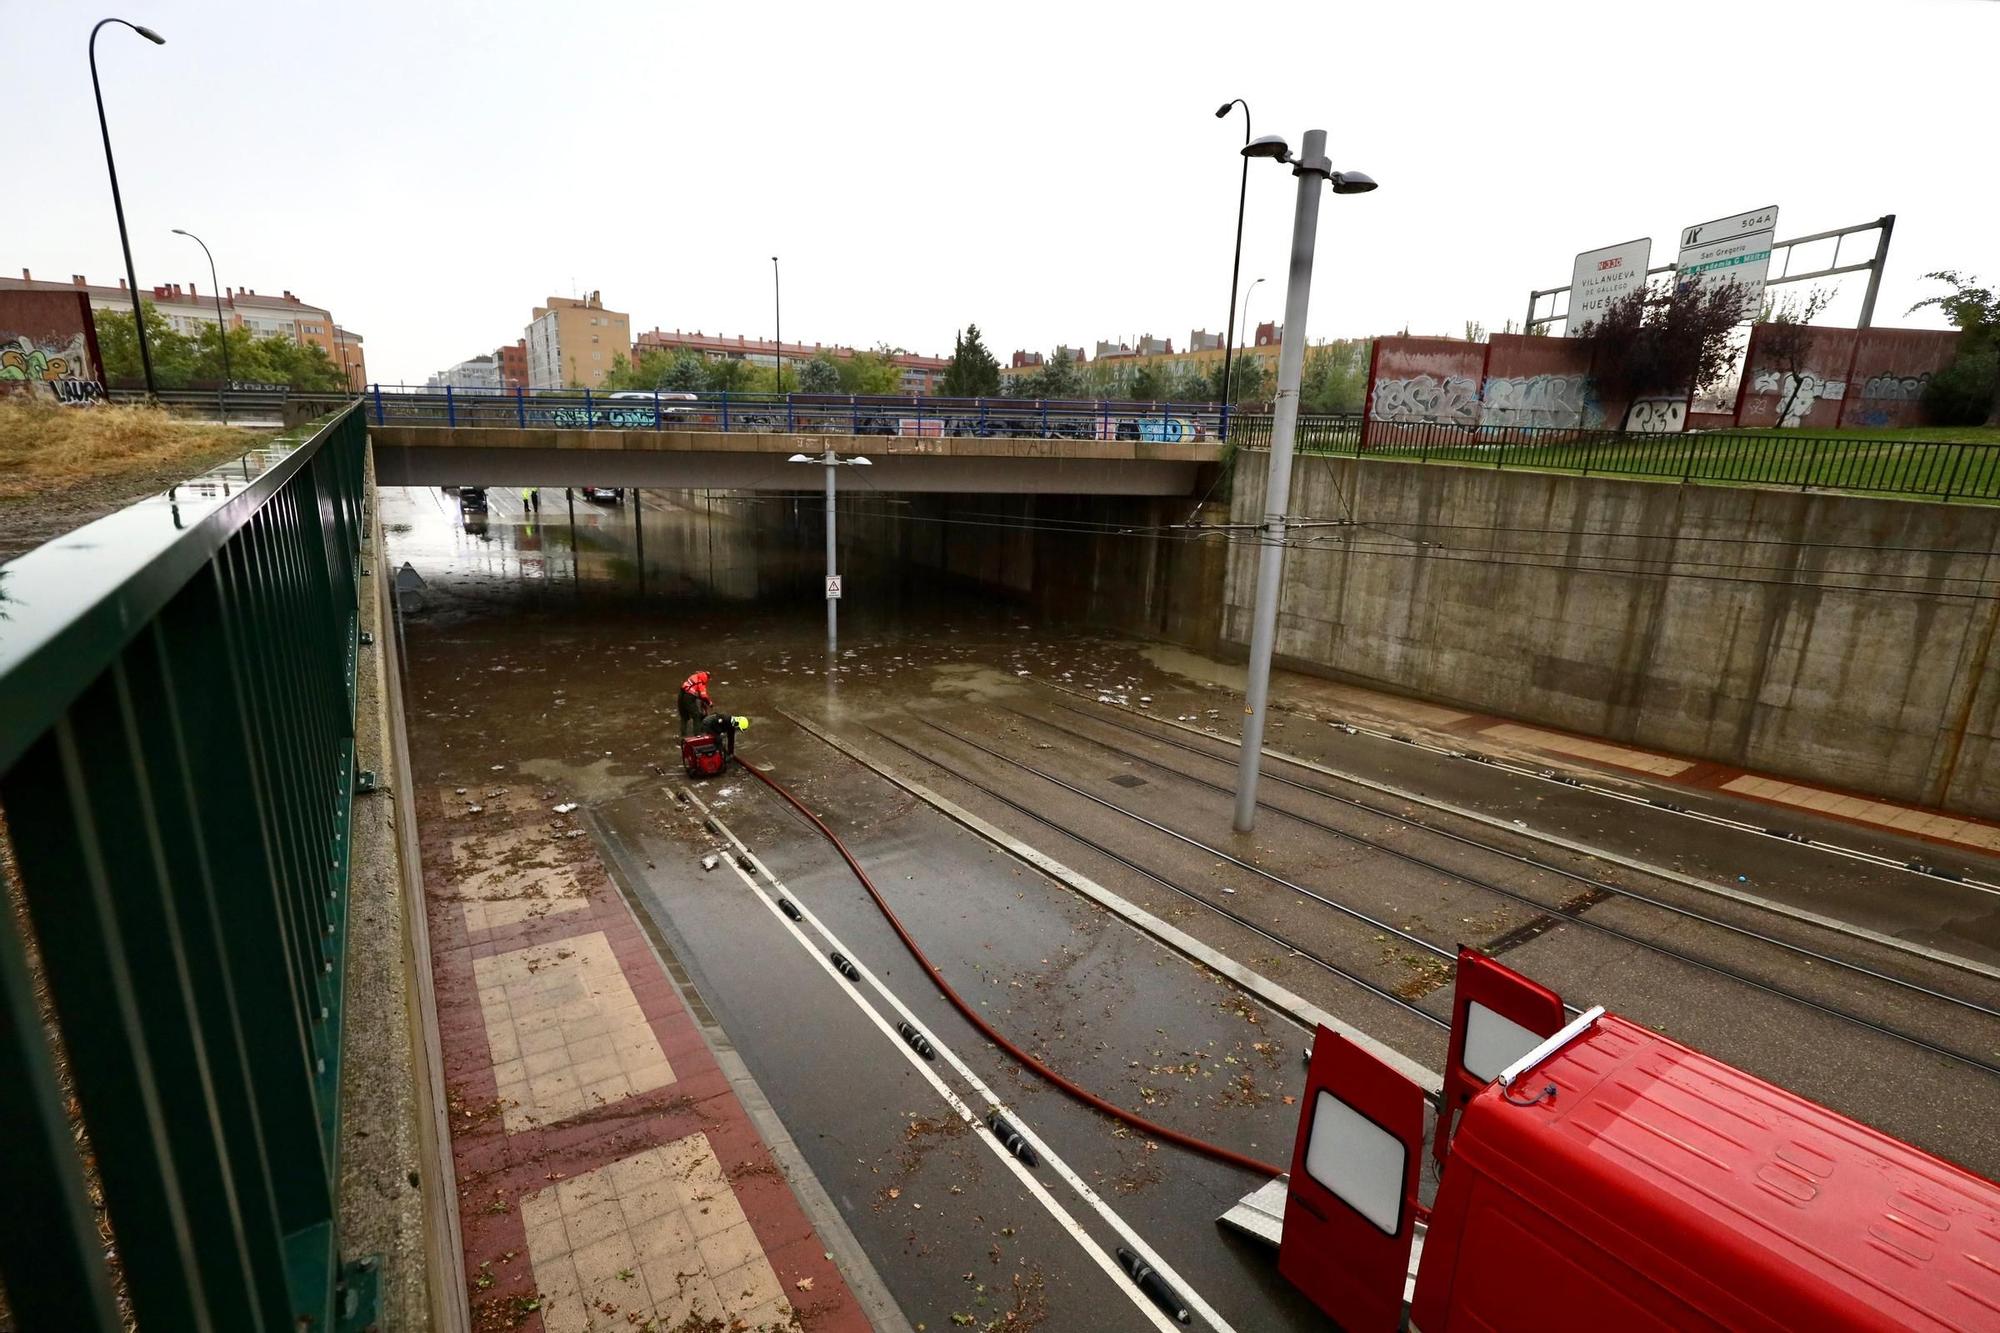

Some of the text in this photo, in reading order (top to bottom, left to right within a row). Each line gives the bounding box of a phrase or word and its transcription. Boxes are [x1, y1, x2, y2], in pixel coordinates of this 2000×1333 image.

[1742, 214, 1771, 228] 504A
[1700, 244, 1746, 260] San Gregorio
[1744, 251, 1770, 262] Militar
[1582, 270, 1635, 287] VILLANUEVA
